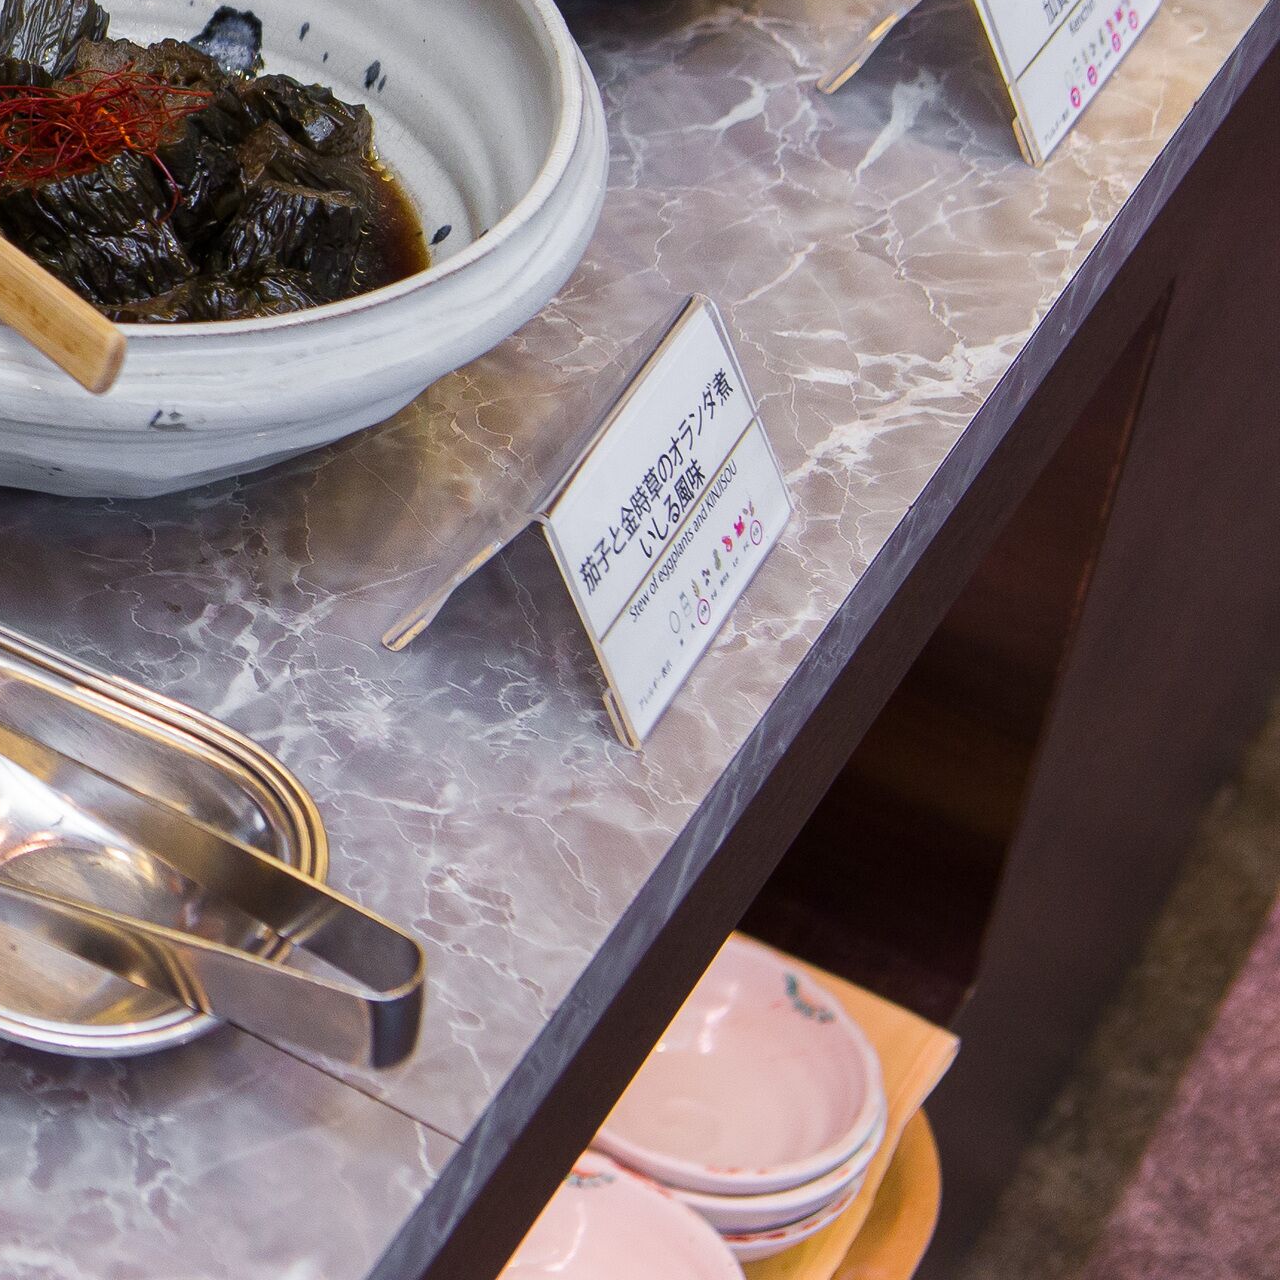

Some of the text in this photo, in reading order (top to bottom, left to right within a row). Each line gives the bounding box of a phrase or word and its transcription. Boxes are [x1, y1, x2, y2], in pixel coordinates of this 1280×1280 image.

[579, 367, 735, 597] 茄子と金時草のオランダ煮
[629, 459, 738, 623] Stew of eggplants and KINJISOU
[639, 458, 706, 559] いしる風味
